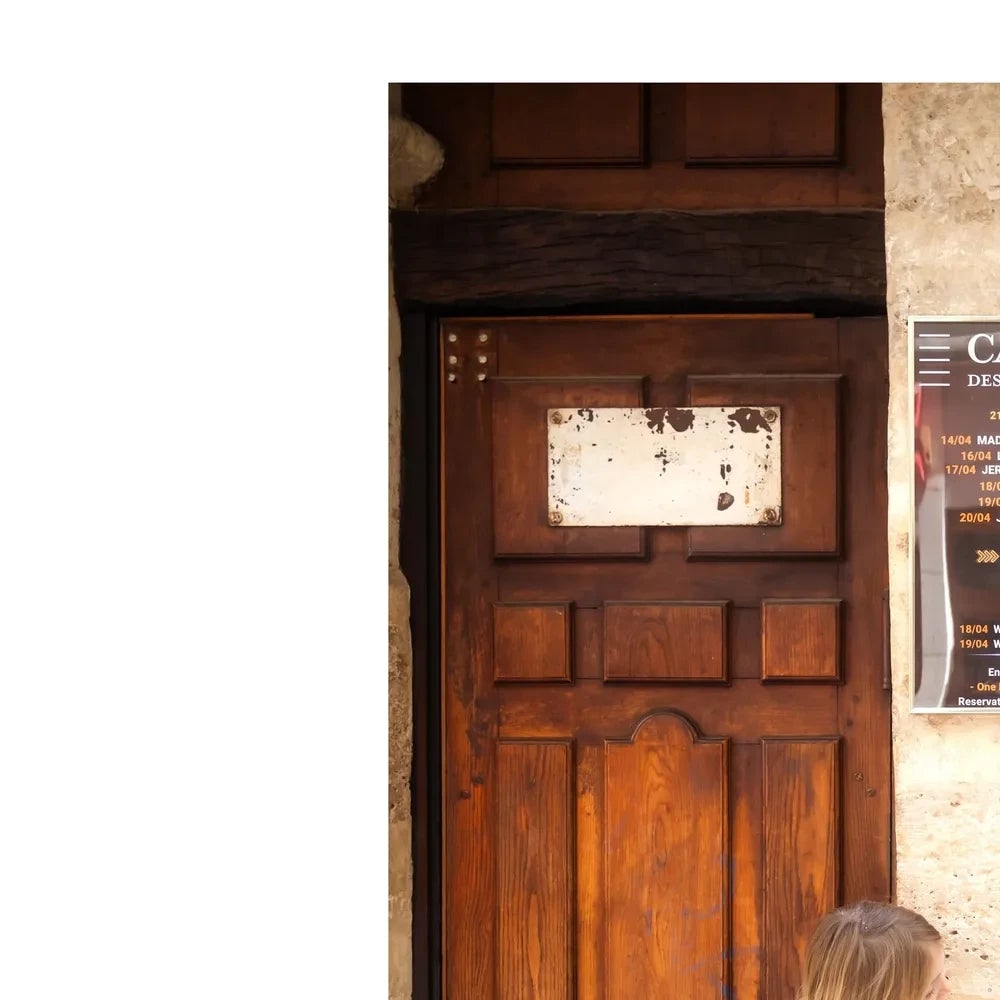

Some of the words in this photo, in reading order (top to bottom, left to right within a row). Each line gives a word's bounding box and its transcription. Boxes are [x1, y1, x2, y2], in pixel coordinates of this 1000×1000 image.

[967, 374, 1000, 387] DES
[941, 436, 971, 446] 14/04
[961, 452, 991, 462] 16/04
[945, 466, 976, 475] 17/04
[960, 513, 990, 524] 20/04
[960, 625, 988, 635] 18/04
[960, 640, 988, 649] 19/04
[977, 683, 996, 691] One
